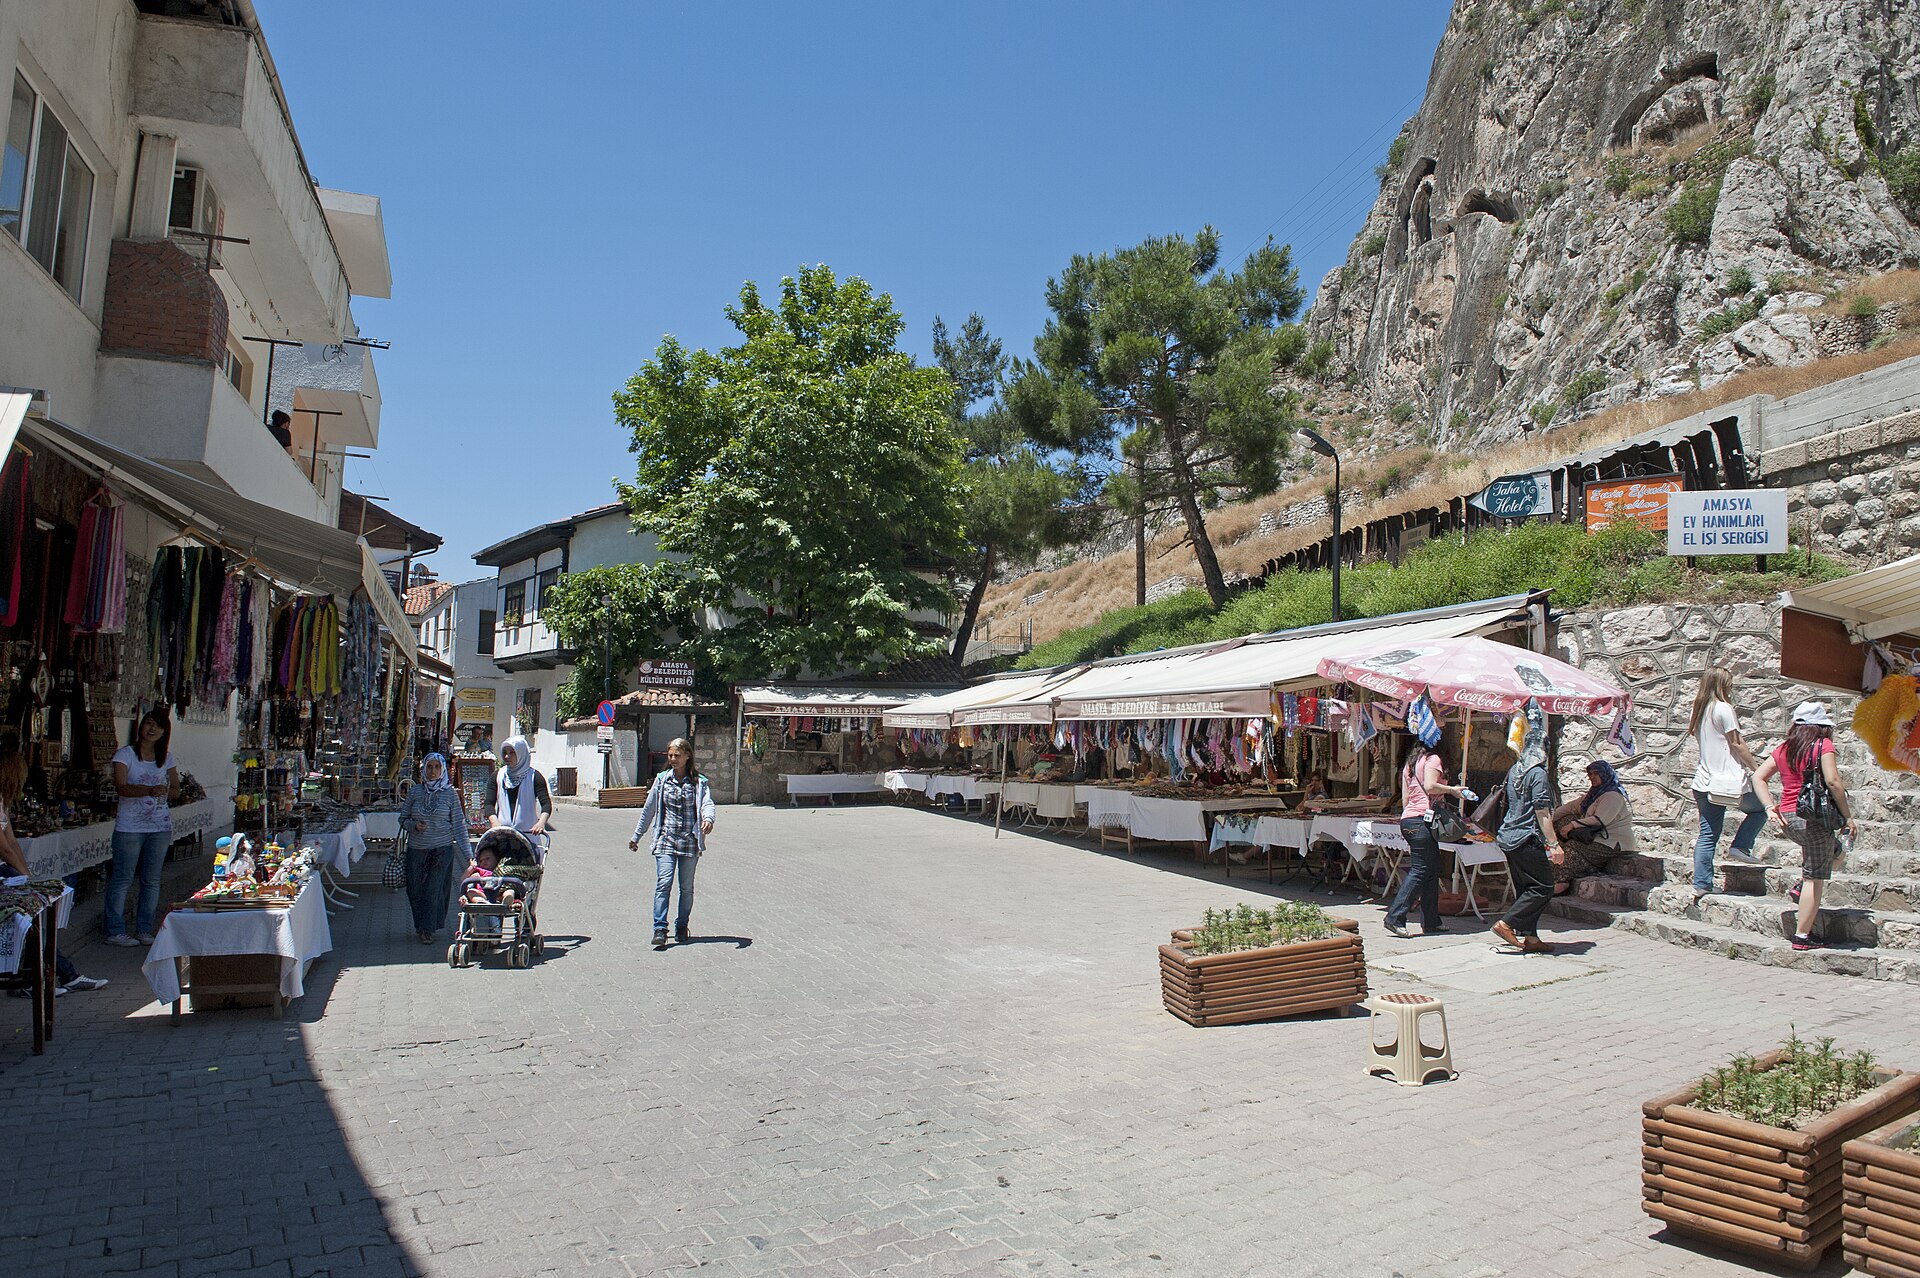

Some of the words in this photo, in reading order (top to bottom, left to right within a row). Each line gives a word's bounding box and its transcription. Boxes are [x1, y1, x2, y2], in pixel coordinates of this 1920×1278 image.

[1492, 481, 1521, 496] Taha
[1590, 488, 1624, 501] Emin
[1628, 483, 1671, 498] Efendi
[1494, 497, 1528, 514] Hotel
[1703, 498, 1752, 511] AMASYA
[1683, 516, 1696, 528] EV
[1702, 514, 1764, 528] HANIMLARI
[1683, 532, 1697, 545] EL
[1701, 530, 1717, 546] İŞİ
[1721, 529, 1769, 545] SERGİSİ
[640, 675, 663, 684] KÜLTÜR
[664, 676, 685, 685] EVLERİ
[1357, 672, 1402, 694] Coca-Cola
[1080, 702, 1108, 715] AMASYA
[1111, 698, 1158, 714] BELEDİYESİ
[1175, 701, 1224, 713] SANATLARI
[1454, 688, 1504, 708] Coca-Cola
[1553, 697, 1591, 714] Coca-Cola
[774, 706, 818, 714] AMASYA
